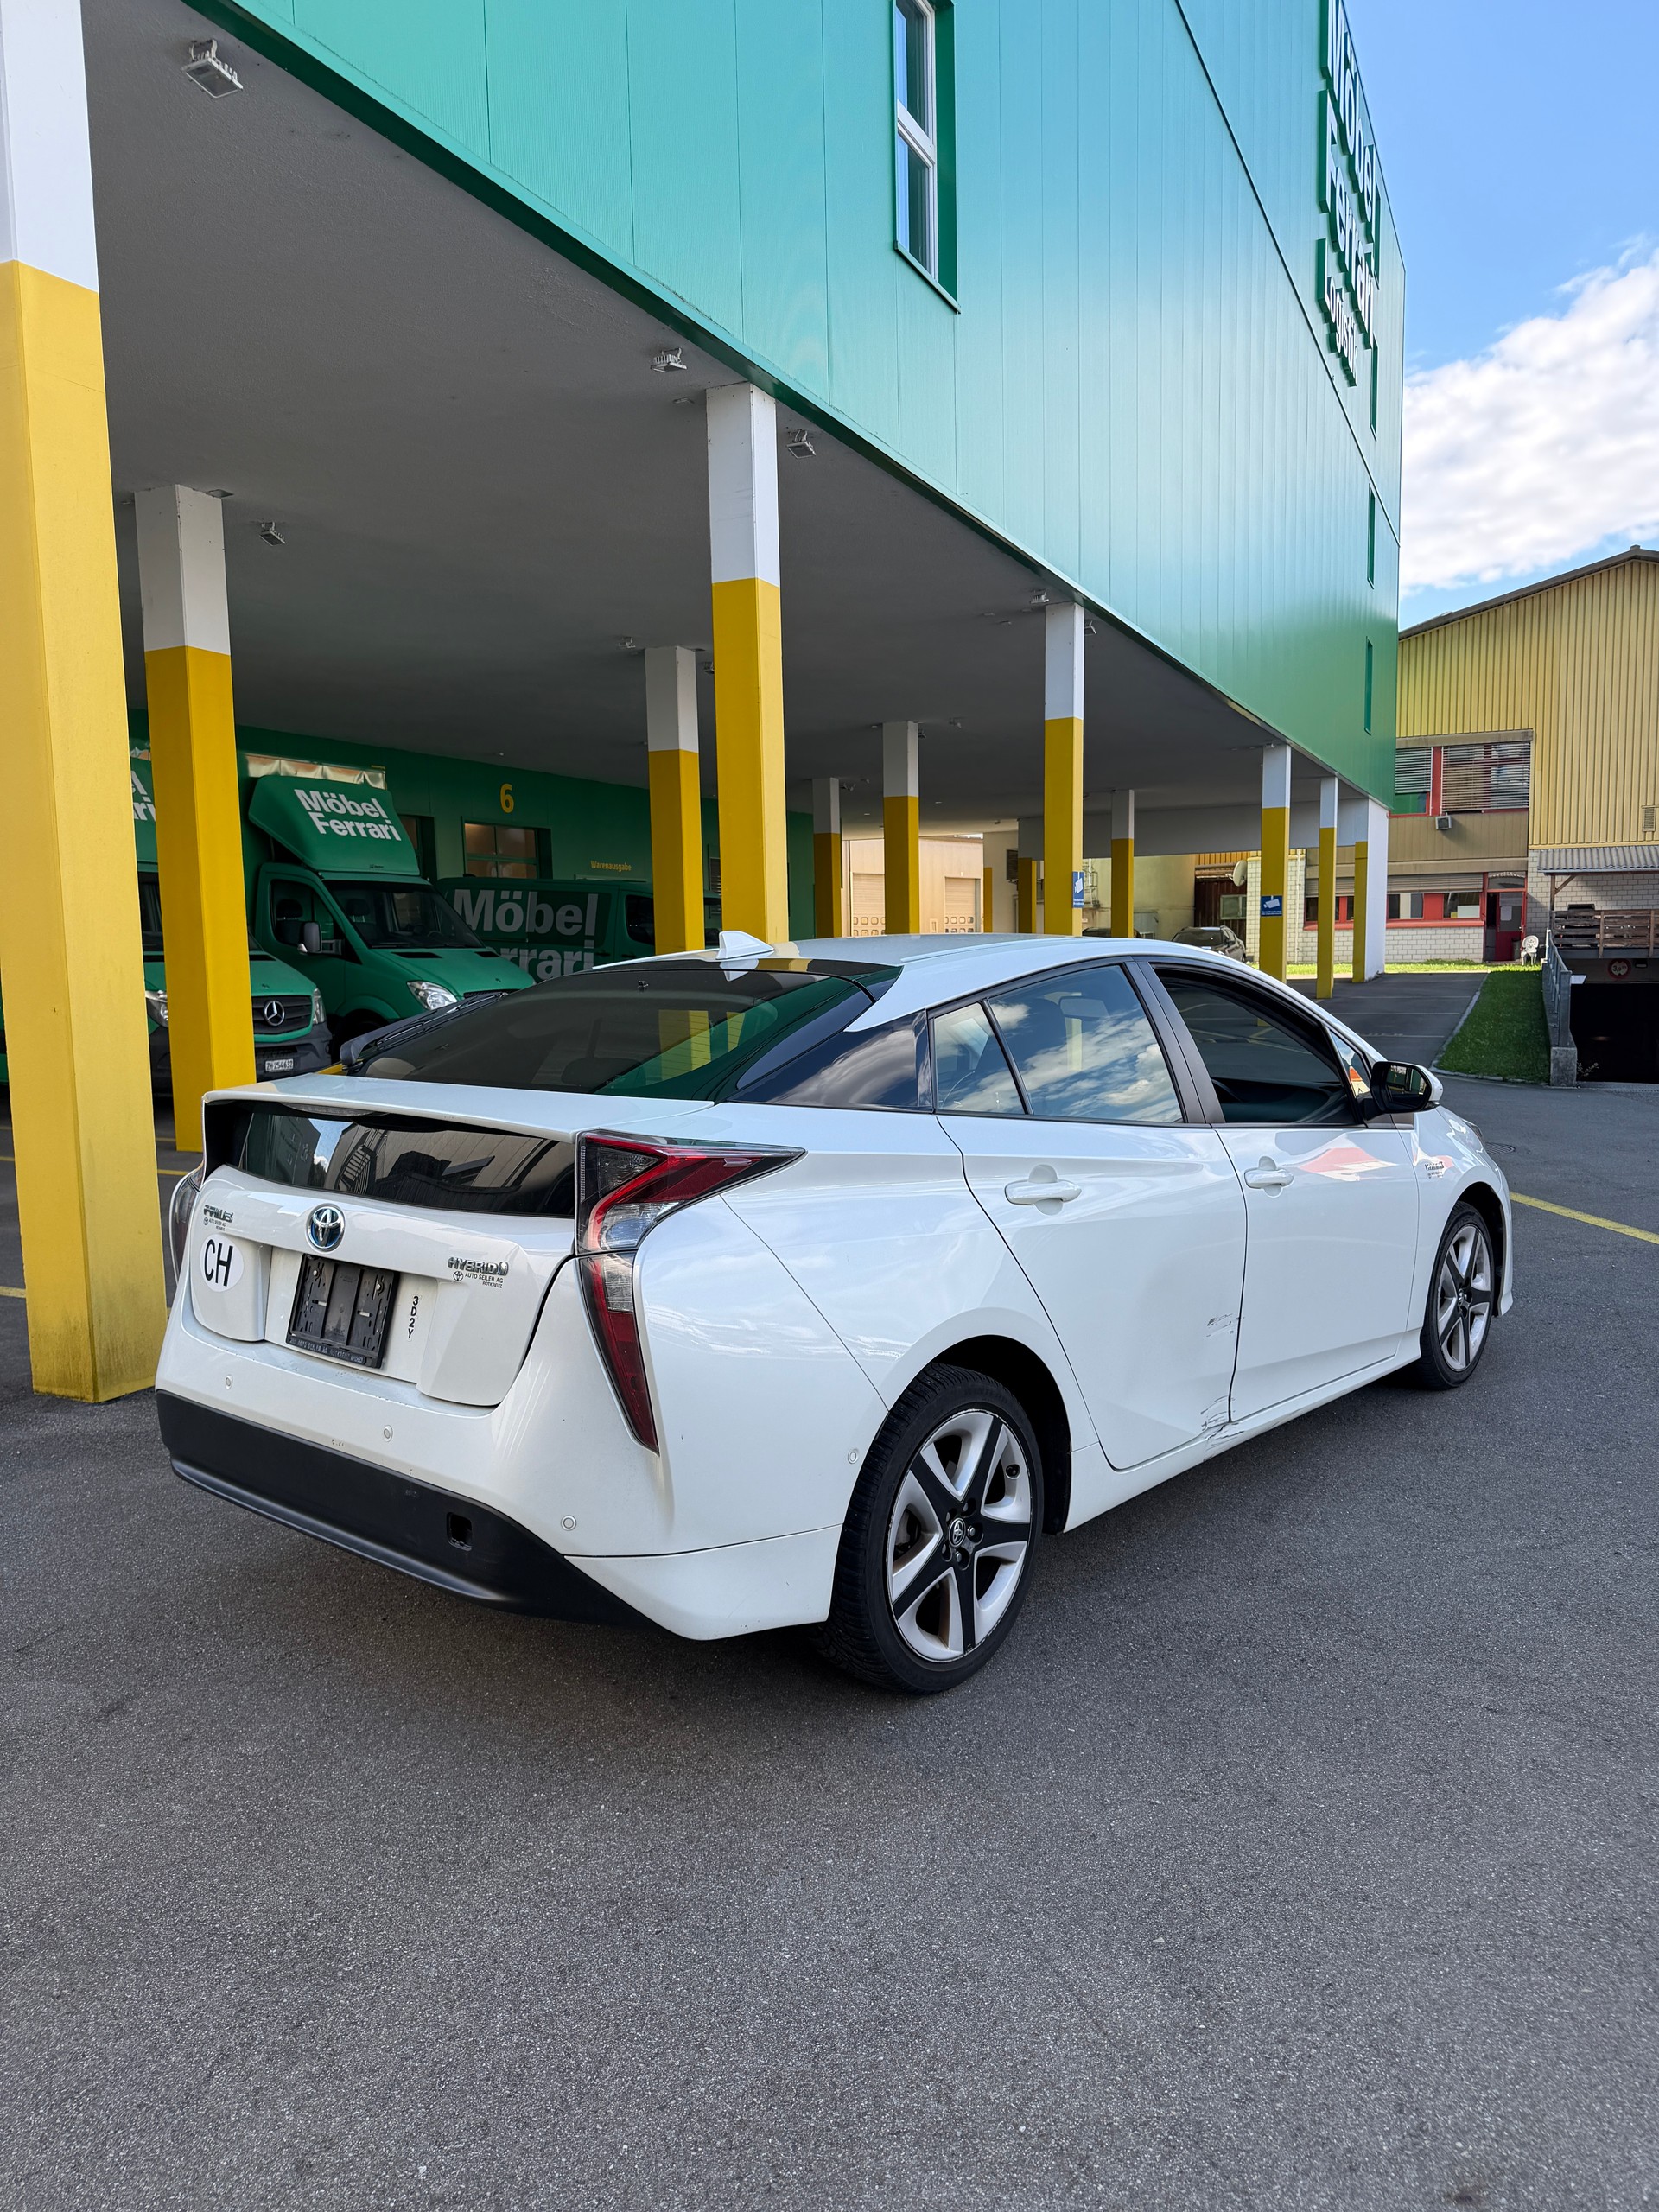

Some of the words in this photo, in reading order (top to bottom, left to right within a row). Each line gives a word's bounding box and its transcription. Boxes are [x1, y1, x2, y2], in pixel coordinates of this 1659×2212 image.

[1323, 90, 1375, 349] Ferrari
[1322, 238, 1357, 386] Logistik
[294, 789, 388, 819] Möbel
[499, 783, 514, 813] 6
[308, 810, 402, 842] Ferrari
[590, 860, 632, 872] Warenausgabe
[454, 889, 599, 936] Möbel
[204, 1238, 233, 1287] CH
[448, 1257, 499, 1274] HYBRID
[479, 1274, 495, 1282] SEILER
